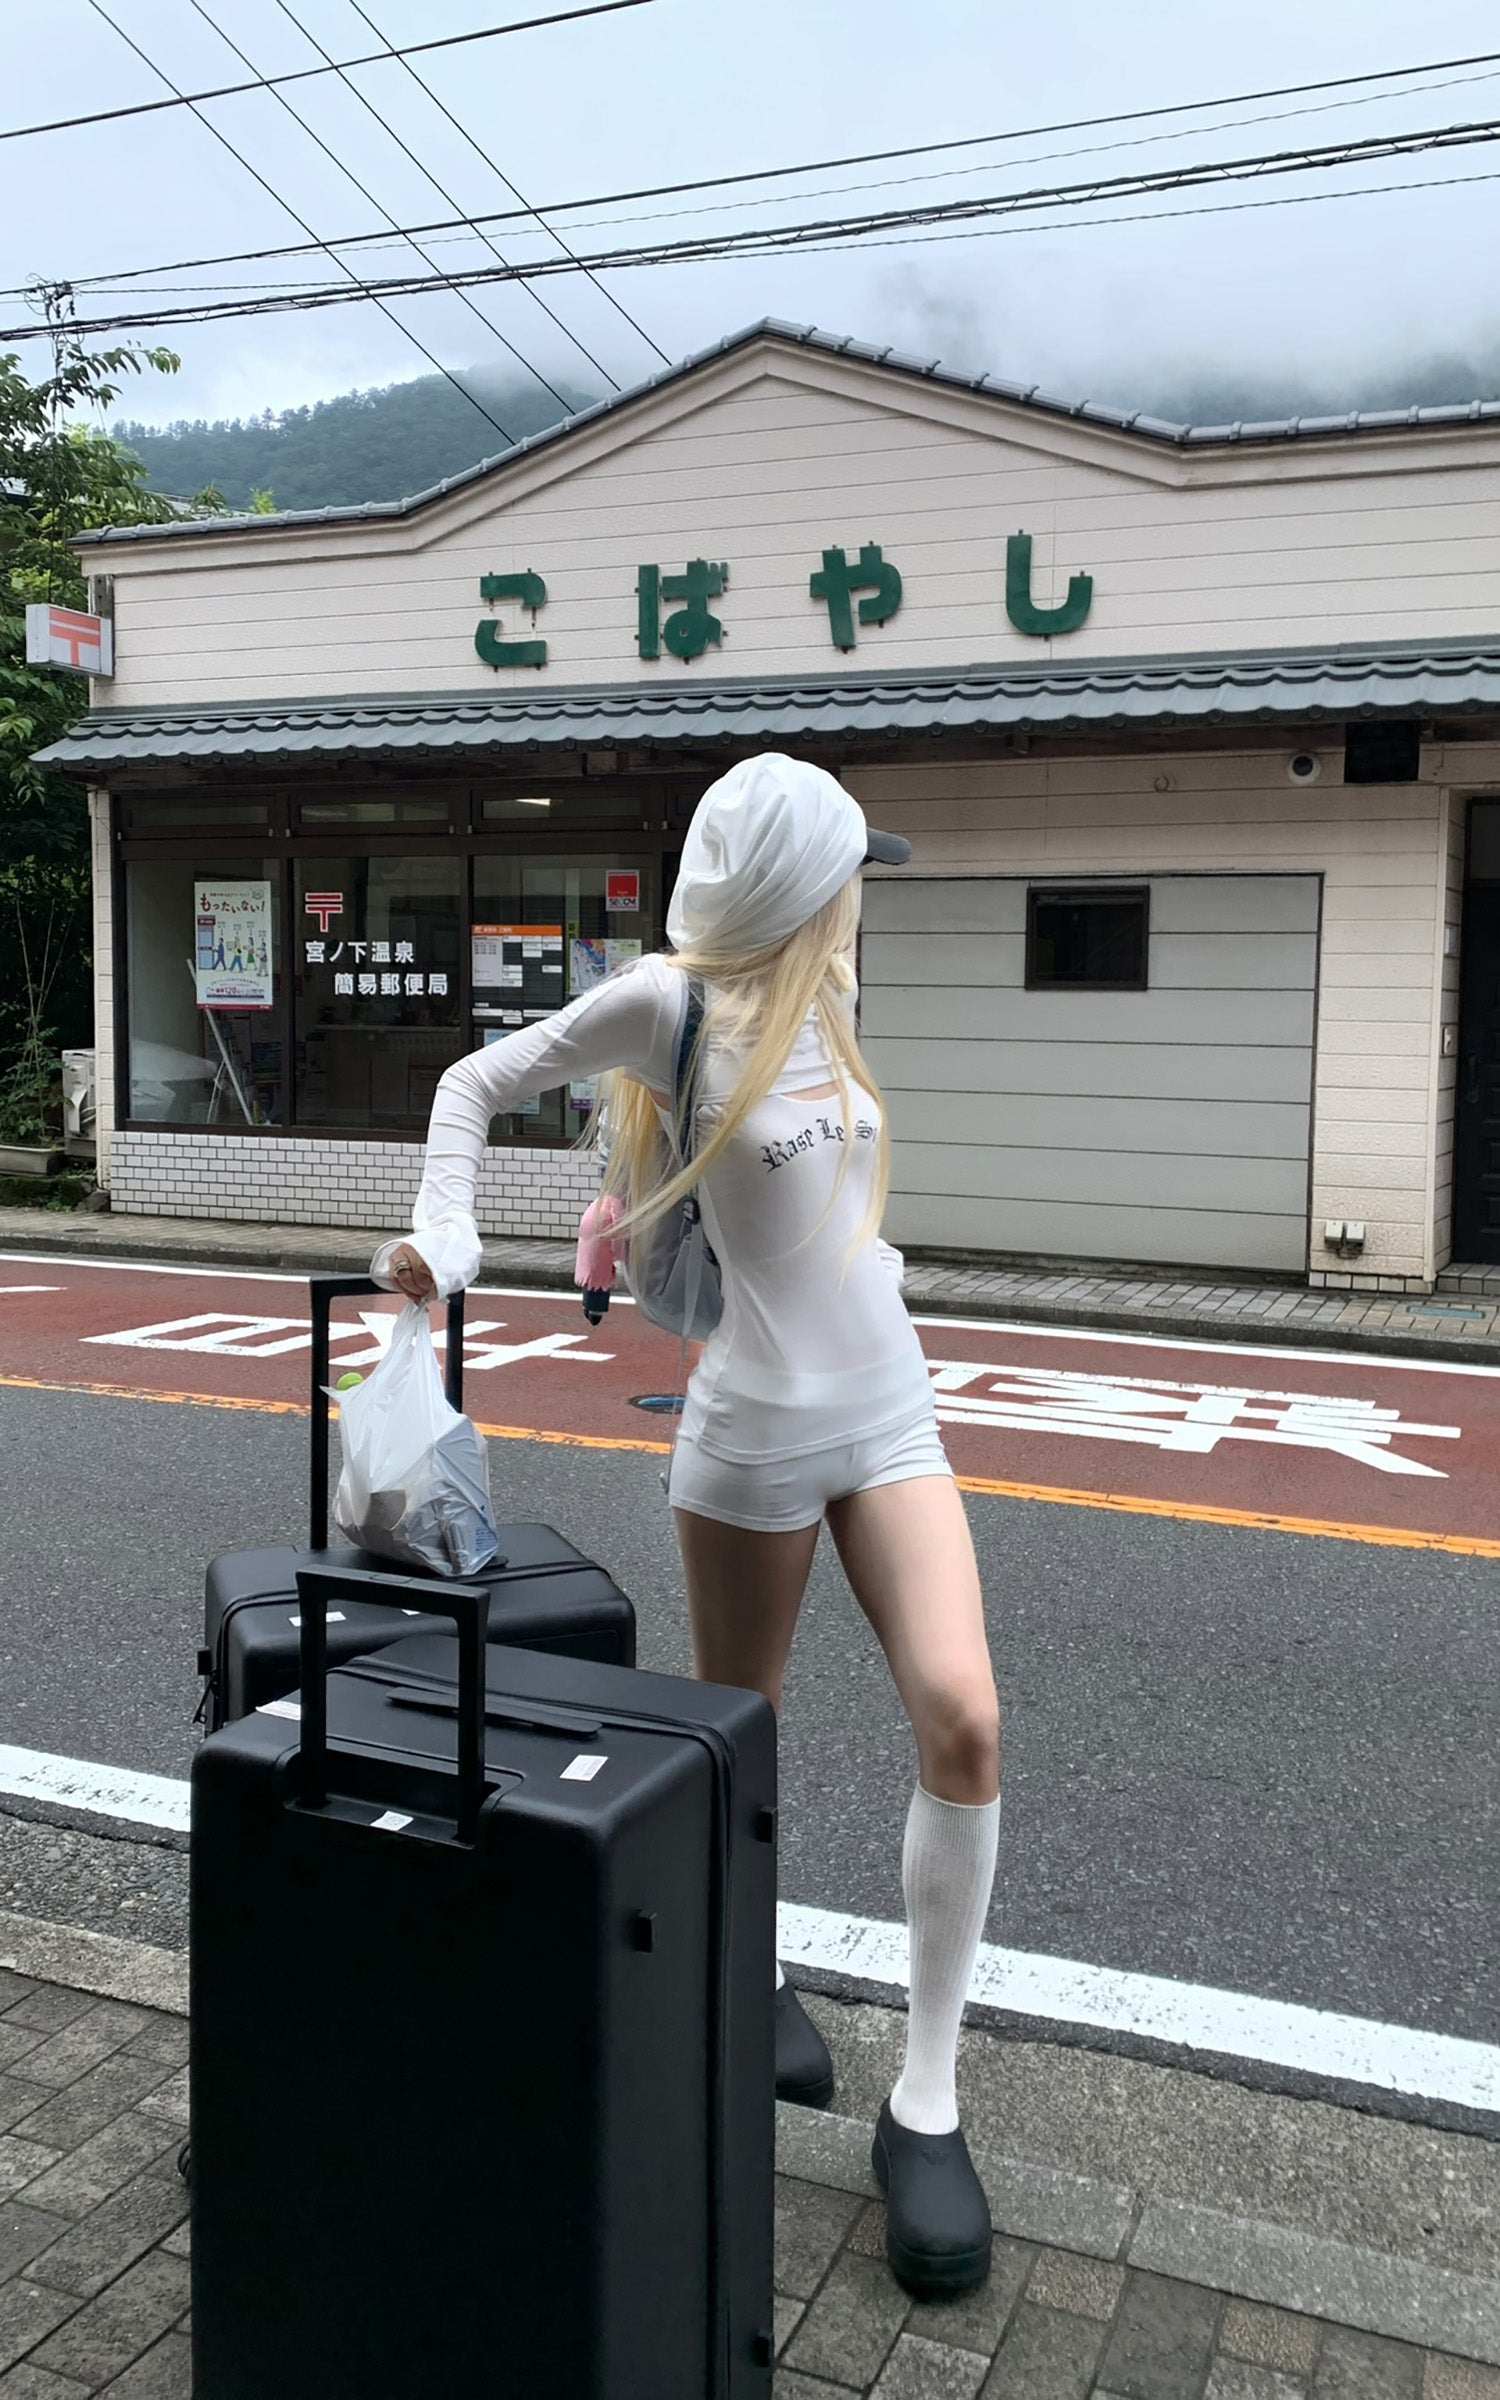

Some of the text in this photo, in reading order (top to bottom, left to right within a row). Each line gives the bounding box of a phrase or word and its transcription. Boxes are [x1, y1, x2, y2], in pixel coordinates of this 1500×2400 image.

[475, 531, 1093, 667] こばやし
[200, 893, 265, 913] もったいない!
[305, 940, 415, 964] 宮ノ下温泉
[334, 973, 448, 996] 簡易郵便局
[816, 1118, 844, 1142] Le
